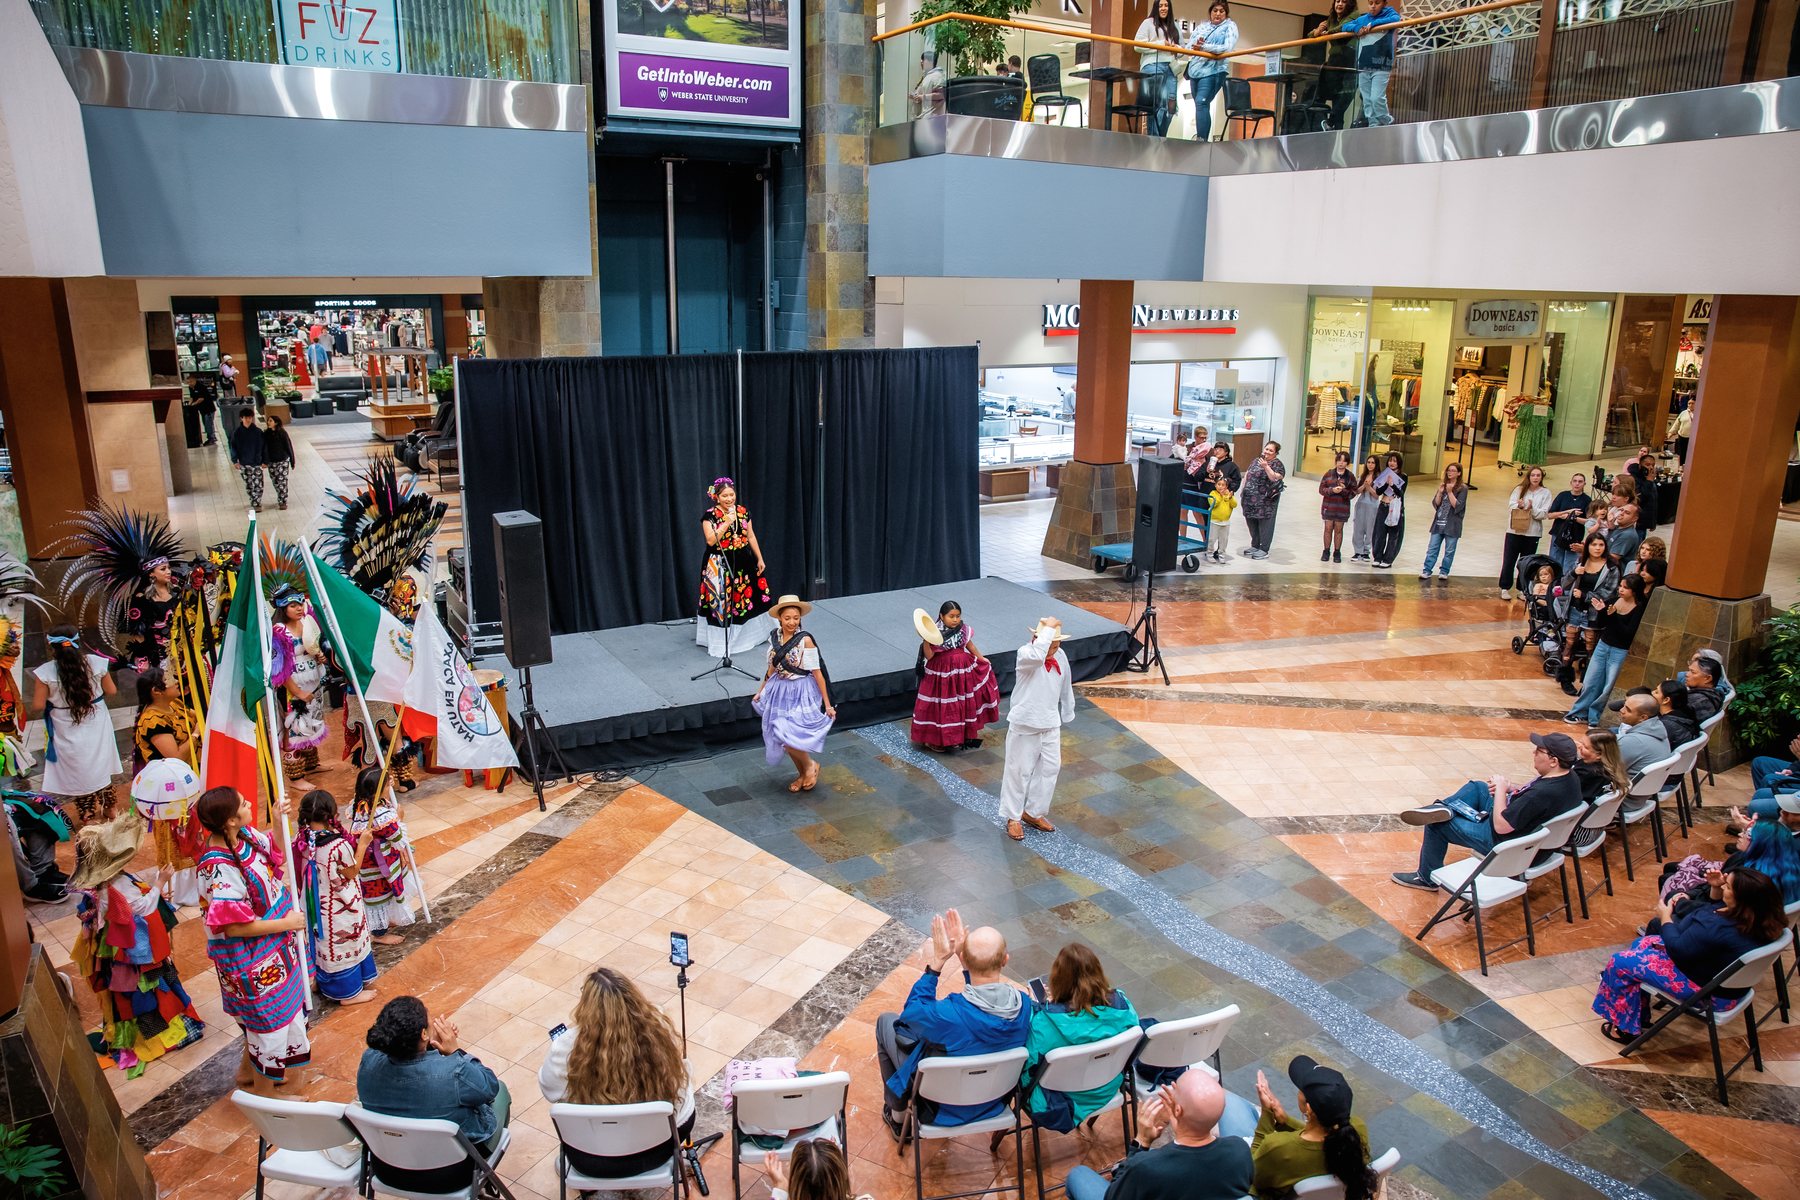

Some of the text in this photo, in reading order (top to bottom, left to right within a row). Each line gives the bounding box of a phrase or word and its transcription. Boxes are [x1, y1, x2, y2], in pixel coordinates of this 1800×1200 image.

[294, 45, 392, 67] DRiNKS
[637, 65, 773, 91] GetIntoWeber.com
[671, 91, 749, 104] WEBER STATE UNIVERSITY
[1149, 308, 1240, 323] JEWELERS
[1472, 308, 1539, 322] DOWNEAST
[1493, 323, 1515, 332] basics
